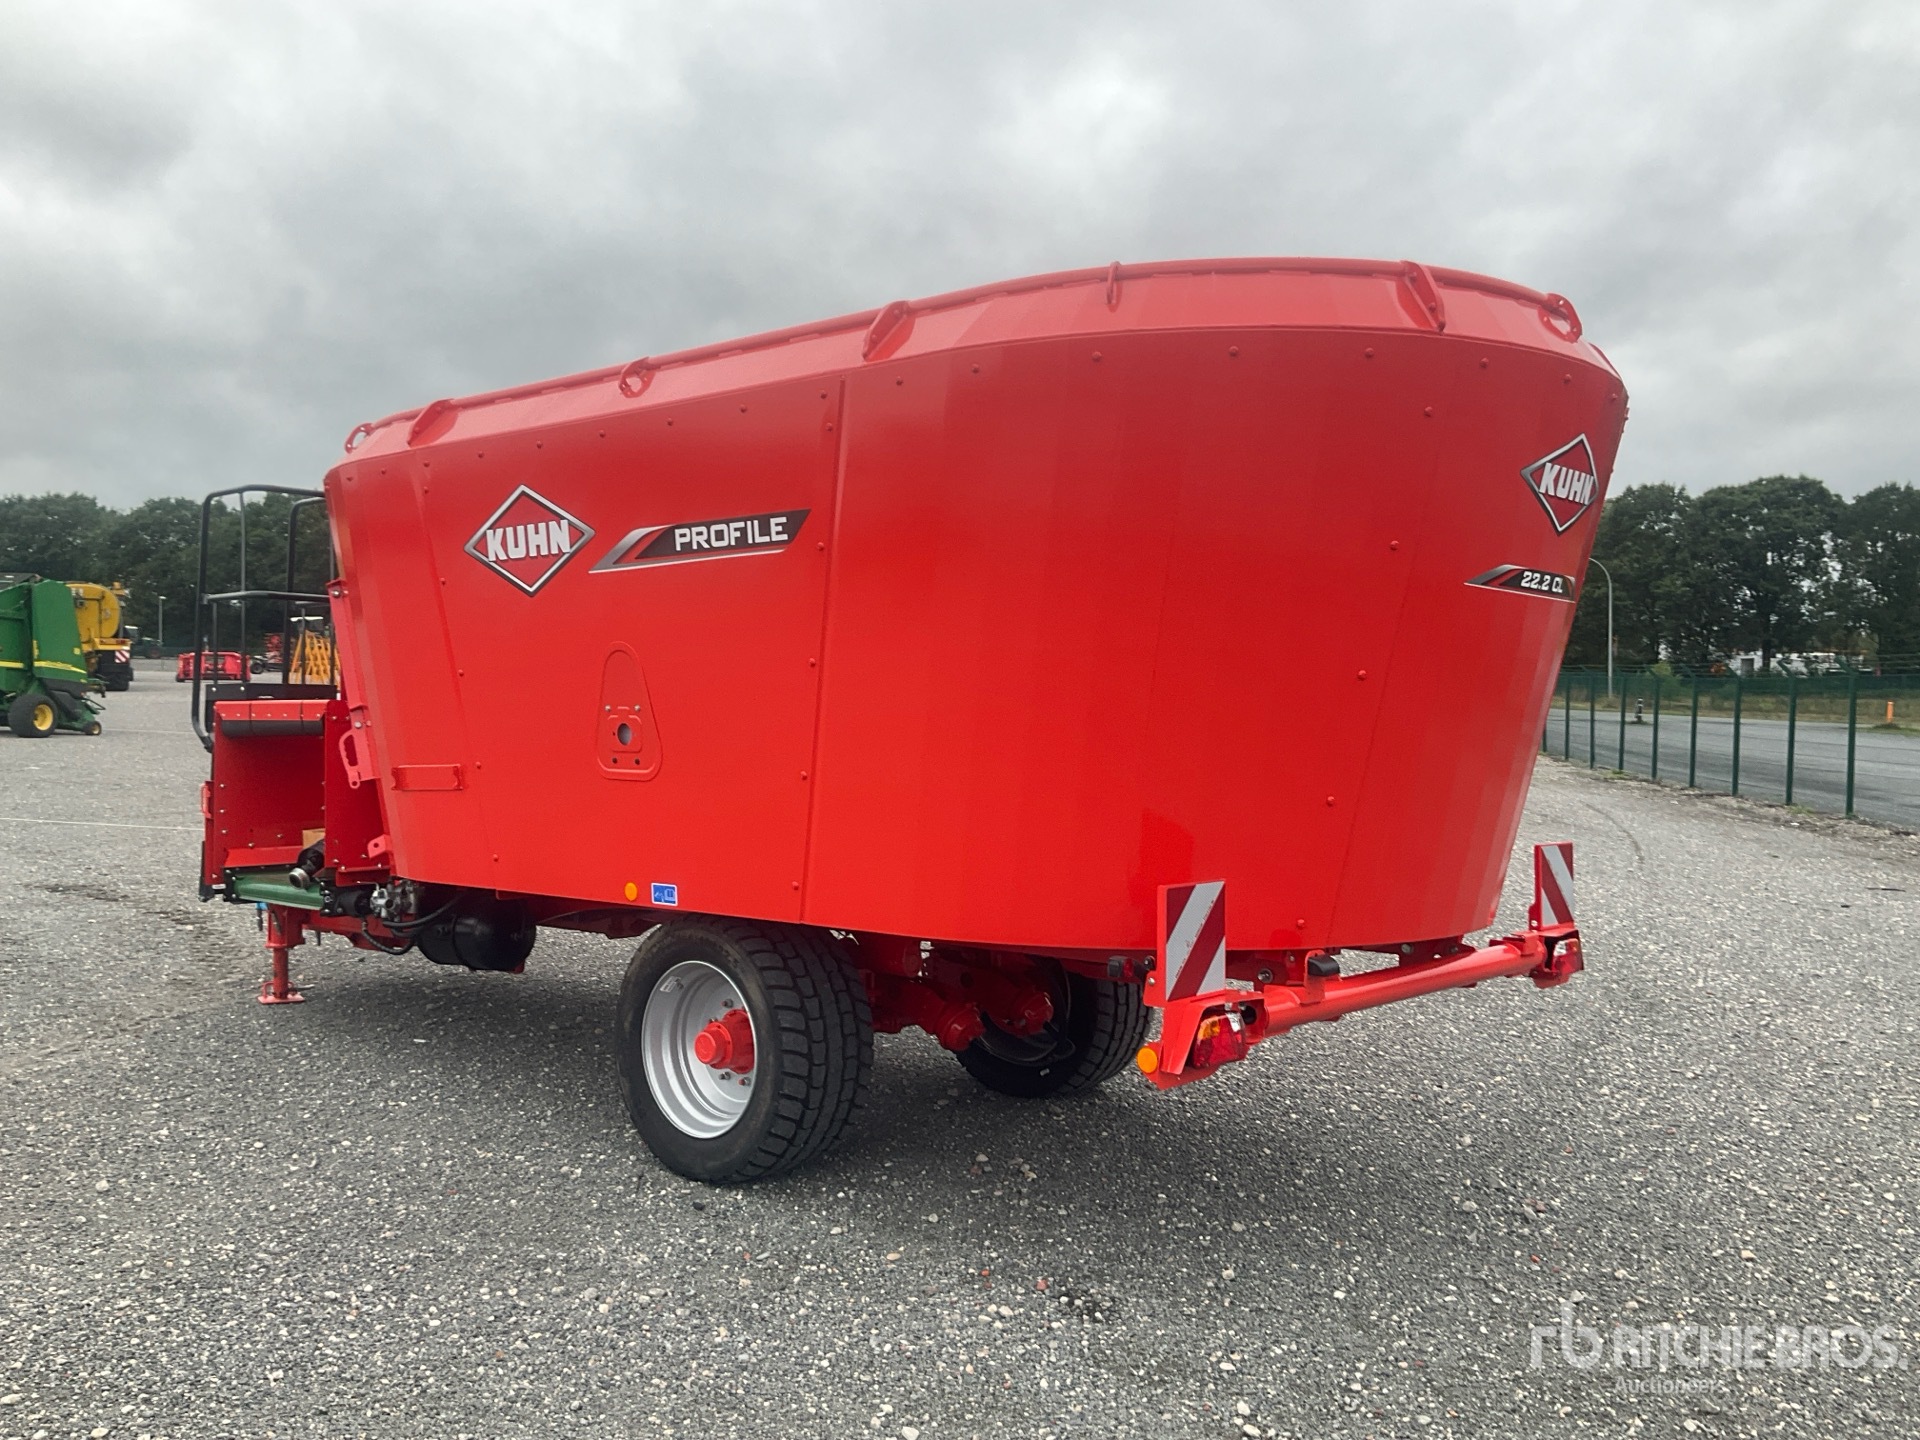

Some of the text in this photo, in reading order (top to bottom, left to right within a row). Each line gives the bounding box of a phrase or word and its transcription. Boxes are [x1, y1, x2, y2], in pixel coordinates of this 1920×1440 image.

[1539, 462, 1595, 506] KUHN
[486, 519, 571, 562] KUHN
[674, 516, 789, 551] PROFILE
[1520, 570, 1551, 591] 22.2
